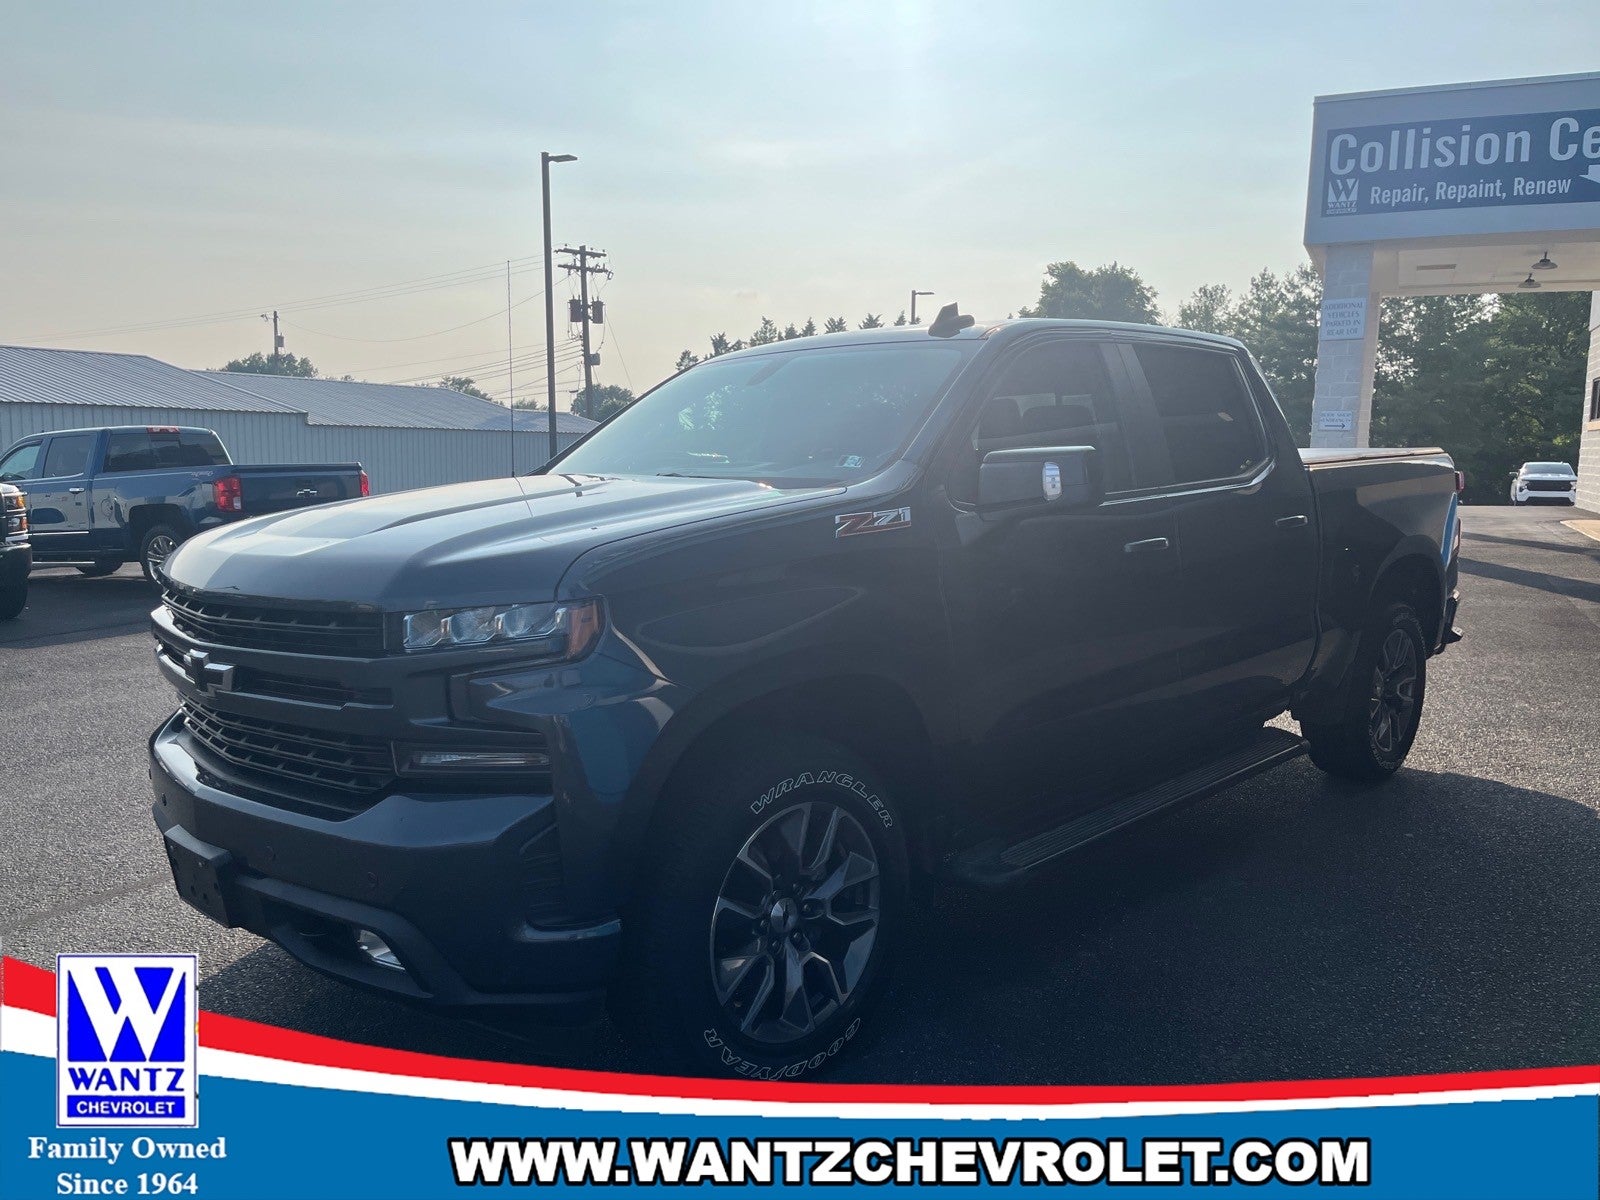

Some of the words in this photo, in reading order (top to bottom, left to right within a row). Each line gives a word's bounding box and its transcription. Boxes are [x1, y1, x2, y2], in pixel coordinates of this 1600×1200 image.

[1329, 124, 1531, 175] Collision
[1328, 201, 1357, 209] WANTZ
[1370, 183, 1429, 207] Repair,
[1435, 179, 1507, 202] Repaint,
[1513, 177, 1572, 196] Renew
[1327, 311, 1360, 319] VEHICLES
[834, 506, 912, 539] Z71
[750, 770, 892, 829] WRANGLER
[703, 1017, 861, 1081] GOODYEAR
